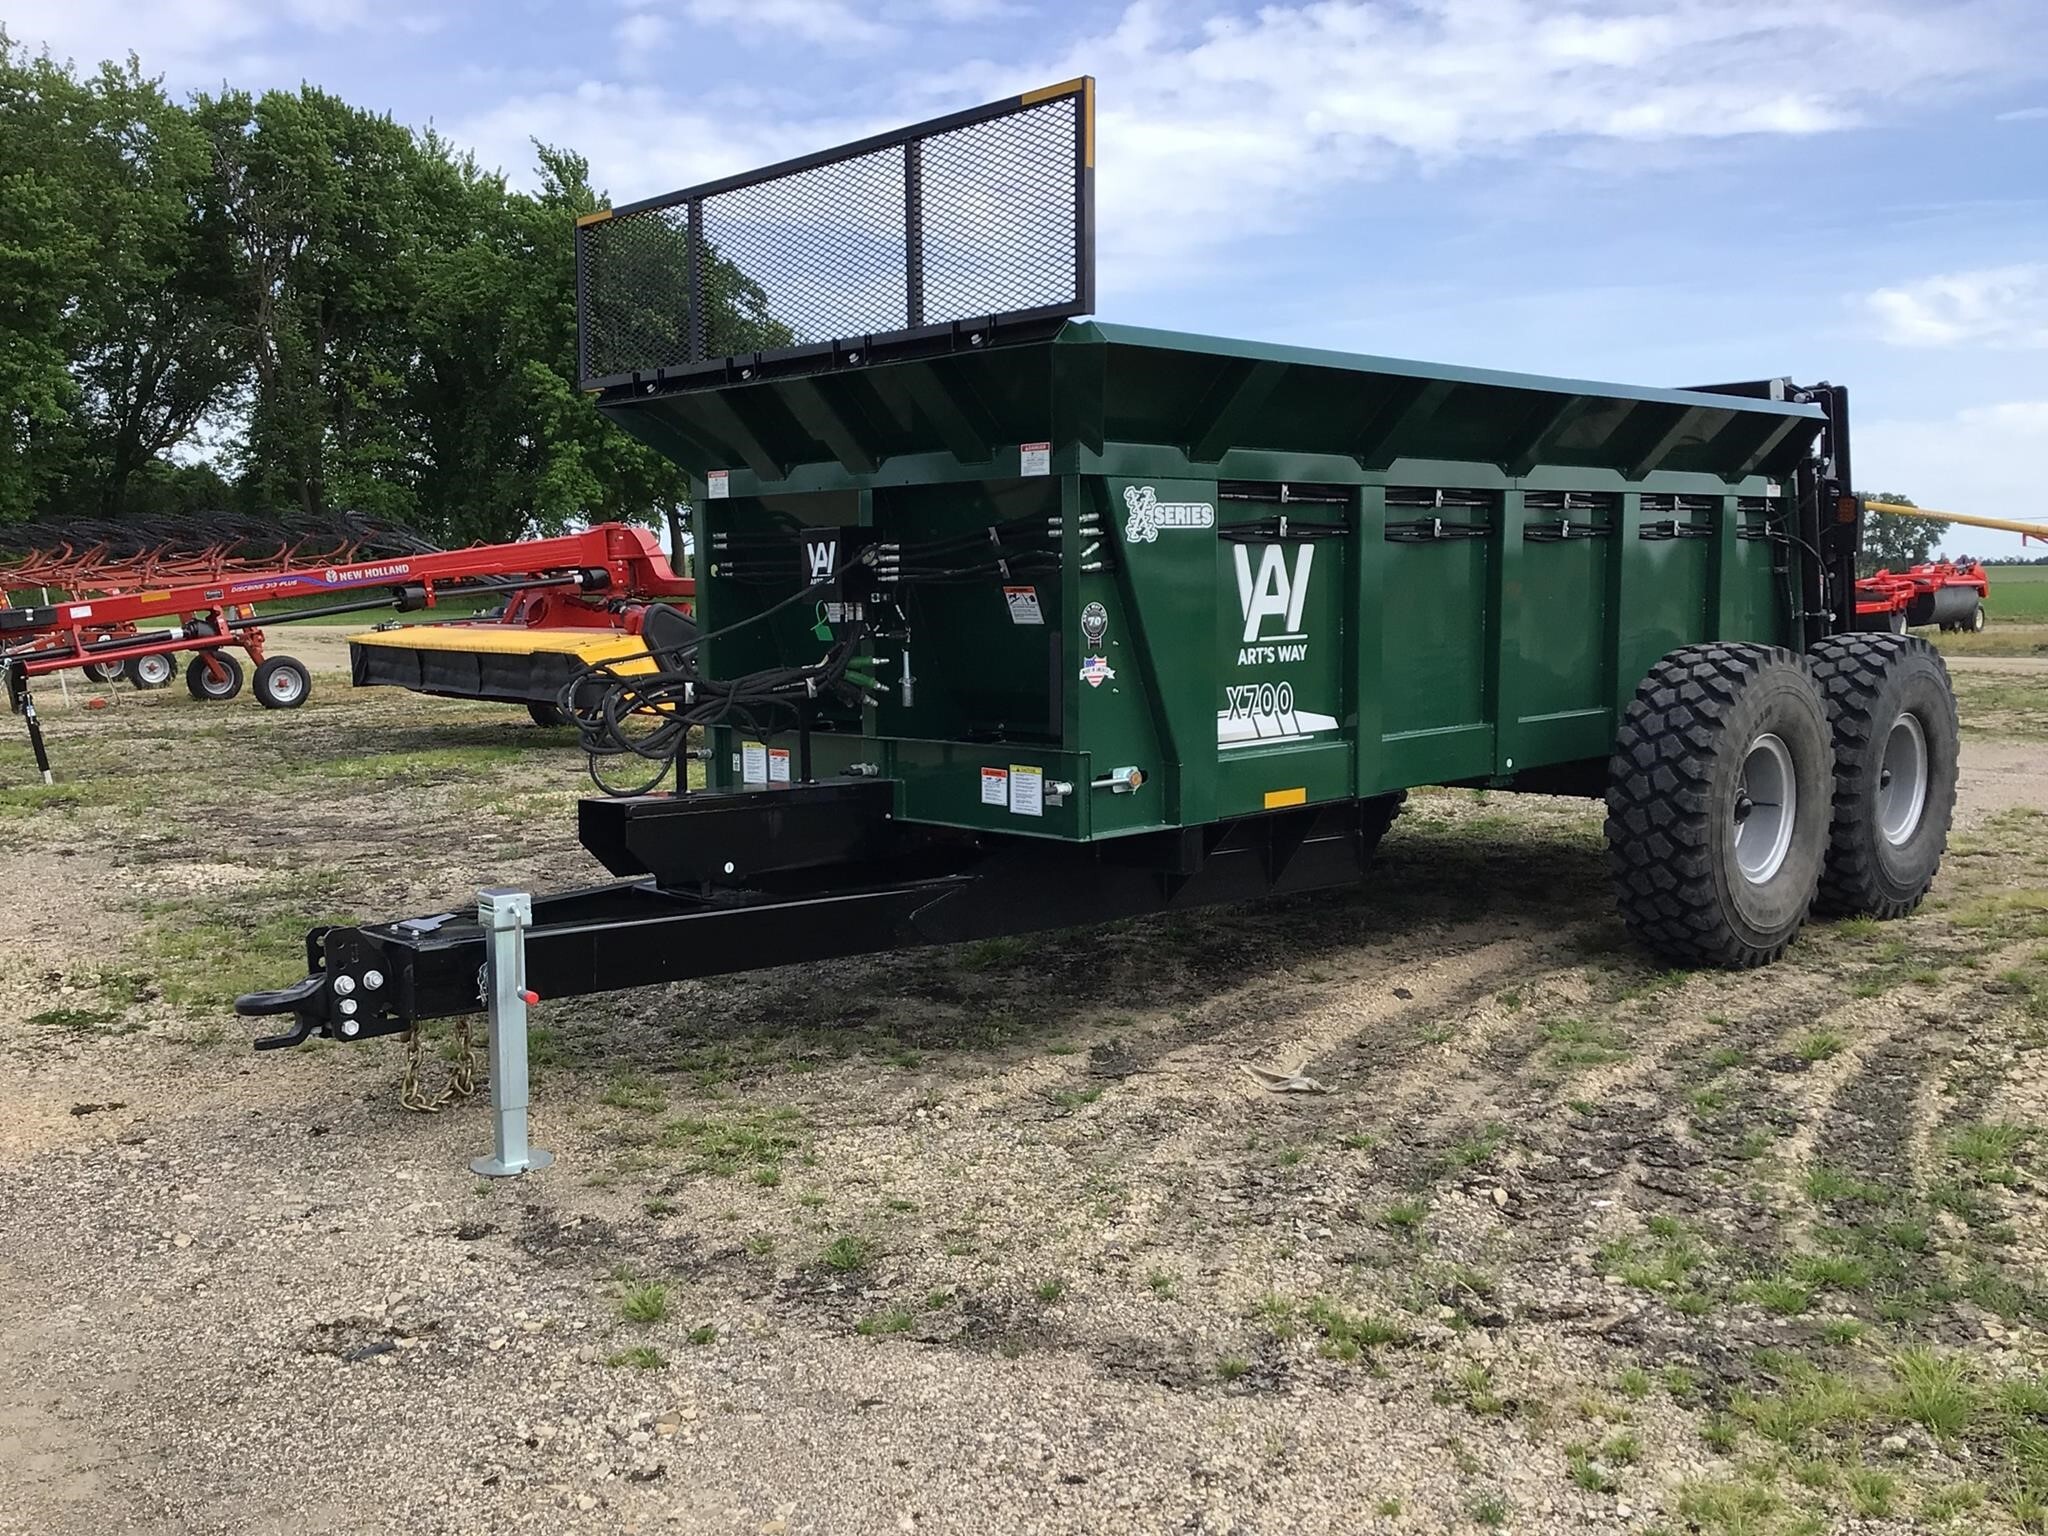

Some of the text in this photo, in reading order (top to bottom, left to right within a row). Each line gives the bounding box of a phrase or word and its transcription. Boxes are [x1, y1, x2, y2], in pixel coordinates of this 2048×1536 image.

[1154, 505, 1213, 526] SERIES
[339, 564, 409, 582] NEW HOLLAND
[278, 579, 298, 588] PLUS
[1087, 616, 1102, 626] 70
[1237, 644, 1308, 666] ART'S WAY
[1226, 681, 1294, 721] X700
